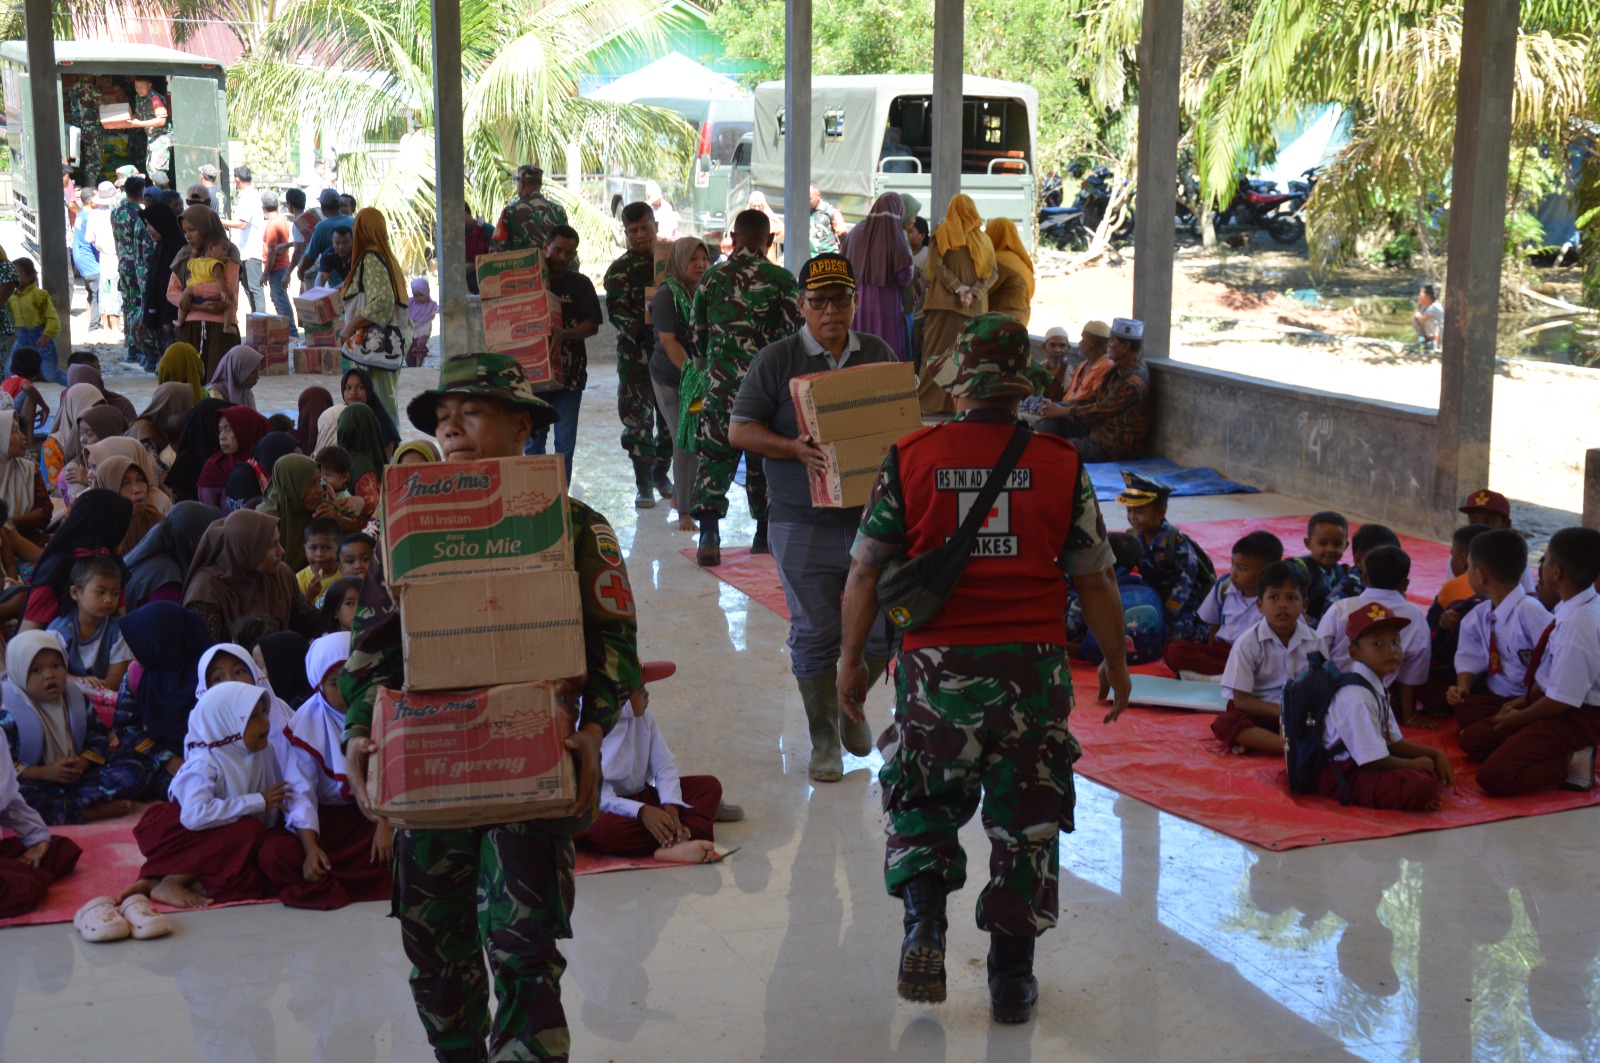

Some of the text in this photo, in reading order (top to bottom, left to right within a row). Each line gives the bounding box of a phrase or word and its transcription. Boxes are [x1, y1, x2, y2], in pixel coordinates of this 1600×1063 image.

[939, 470, 950, 487] RS
[953, 470, 967, 487] TNI
[970, 470, 982, 487] AD
[1011, 470, 1029, 487] PSP
[420, 513, 471, 526] Mi Instan
[433, 537, 522, 560] Soto Mie
[967, 538, 1013, 554] AKES
[406, 737, 457, 750] Mi Instan
[423, 755, 526, 778] Mi goreng
